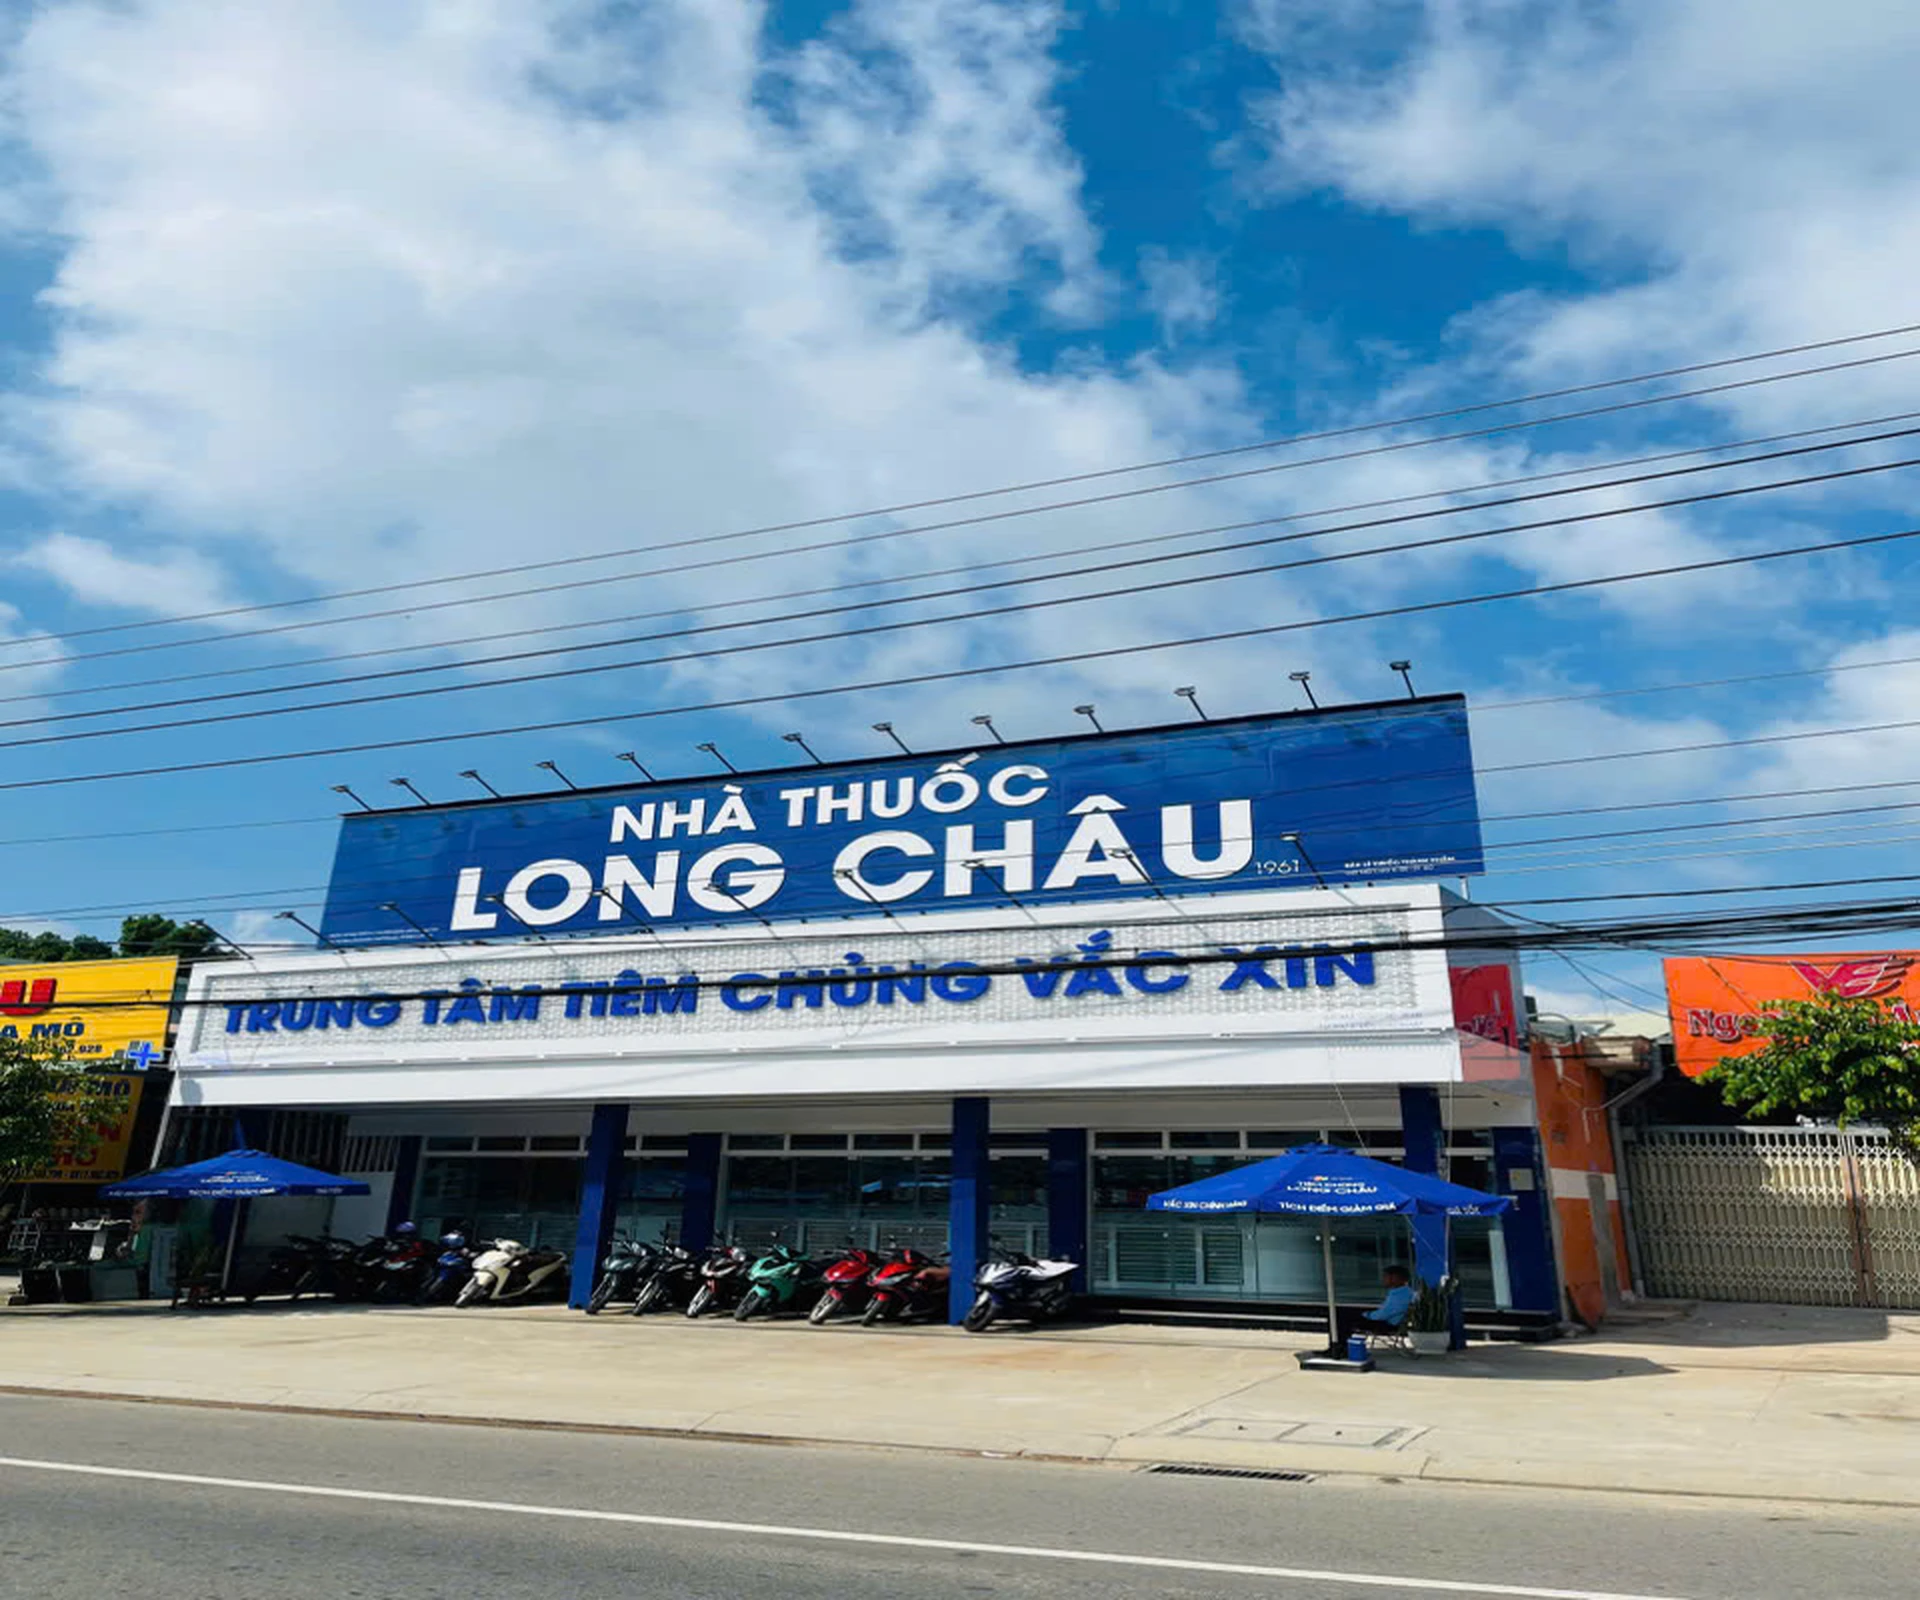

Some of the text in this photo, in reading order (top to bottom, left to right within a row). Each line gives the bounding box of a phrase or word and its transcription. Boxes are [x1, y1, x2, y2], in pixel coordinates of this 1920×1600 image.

[609, 752, 1049, 843] NHÀ THUỐC
[449, 794, 1253, 931] LONG CHÂU
[1256, 859, 1299, 875] 1961
[223, 929, 1376, 1034] TRUNG TÂM TIÊM CHỦNG VẮC XIN
